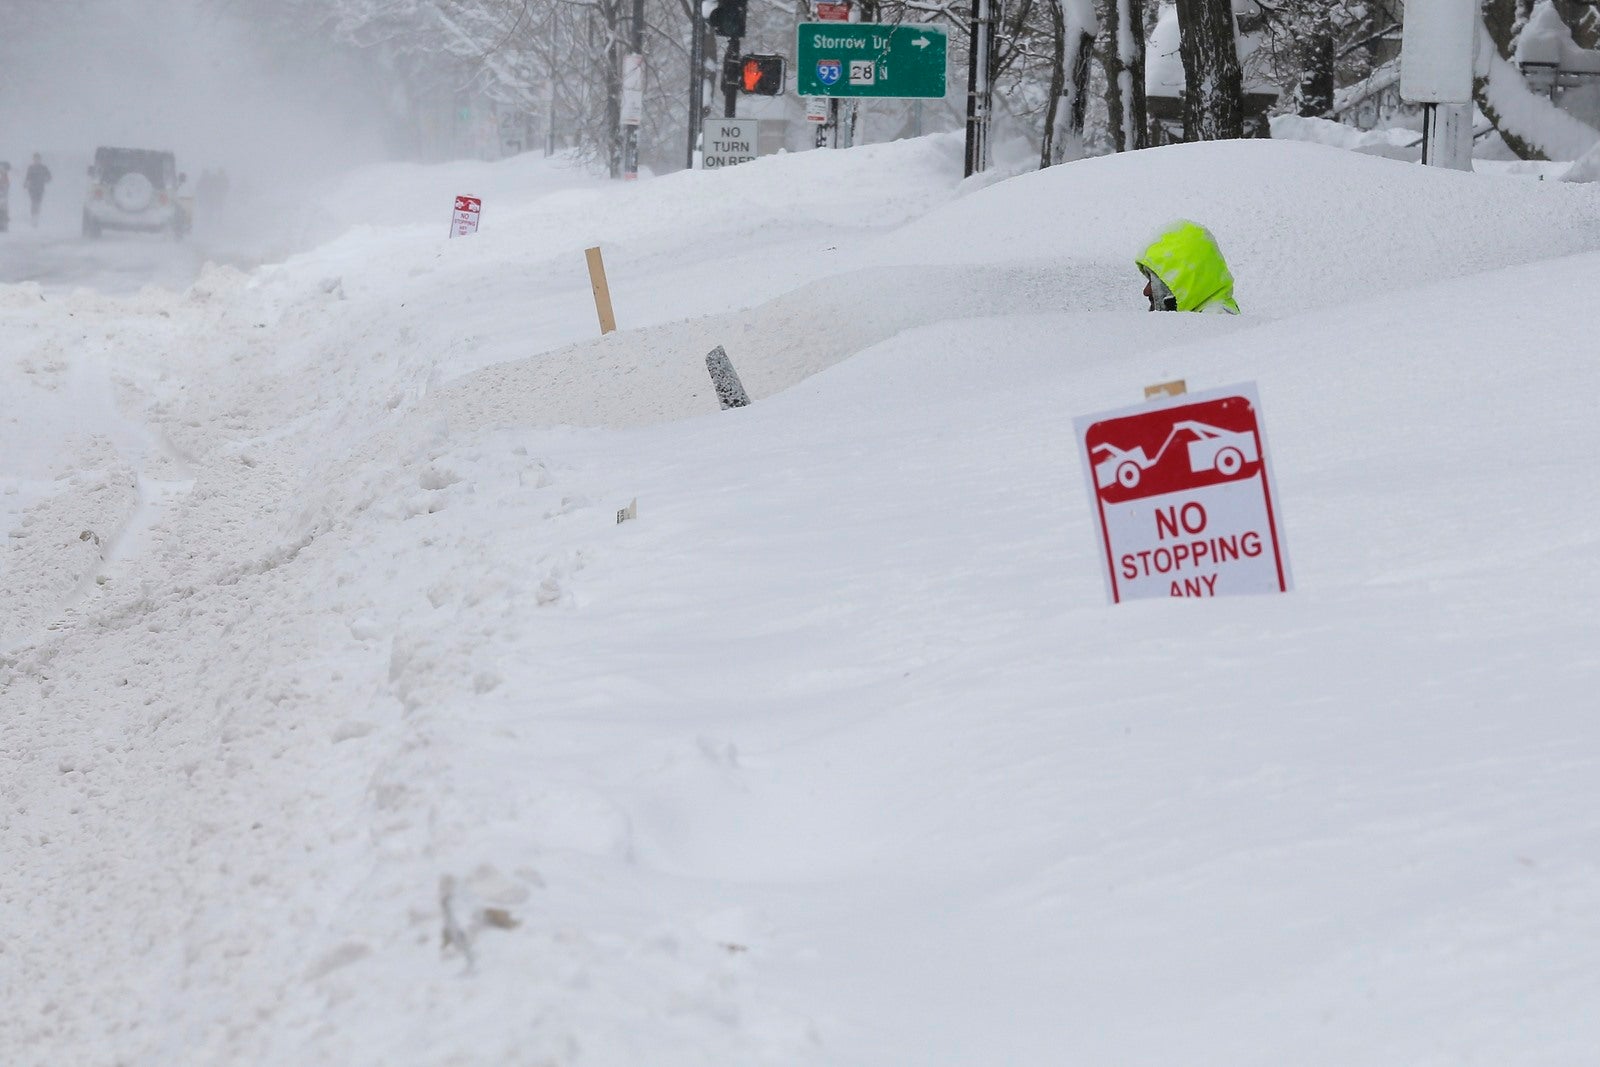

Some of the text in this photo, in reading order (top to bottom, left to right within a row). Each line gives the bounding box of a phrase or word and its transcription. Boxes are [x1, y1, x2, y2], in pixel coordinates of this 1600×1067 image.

[813, 34, 866, 49] Storrow
[819, 66, 839, 80] 93
[850, 66, 872, 80] 28
[721, 127, 741, 138] NO
[713, 141, 750, 152] TURN
[705, 156, 726, 167] ON
[1154, 501, 1208, 540] NO
[1120, 531, 1263, 580] STOPPING
[1169, 572, 1218, 598] ANY
